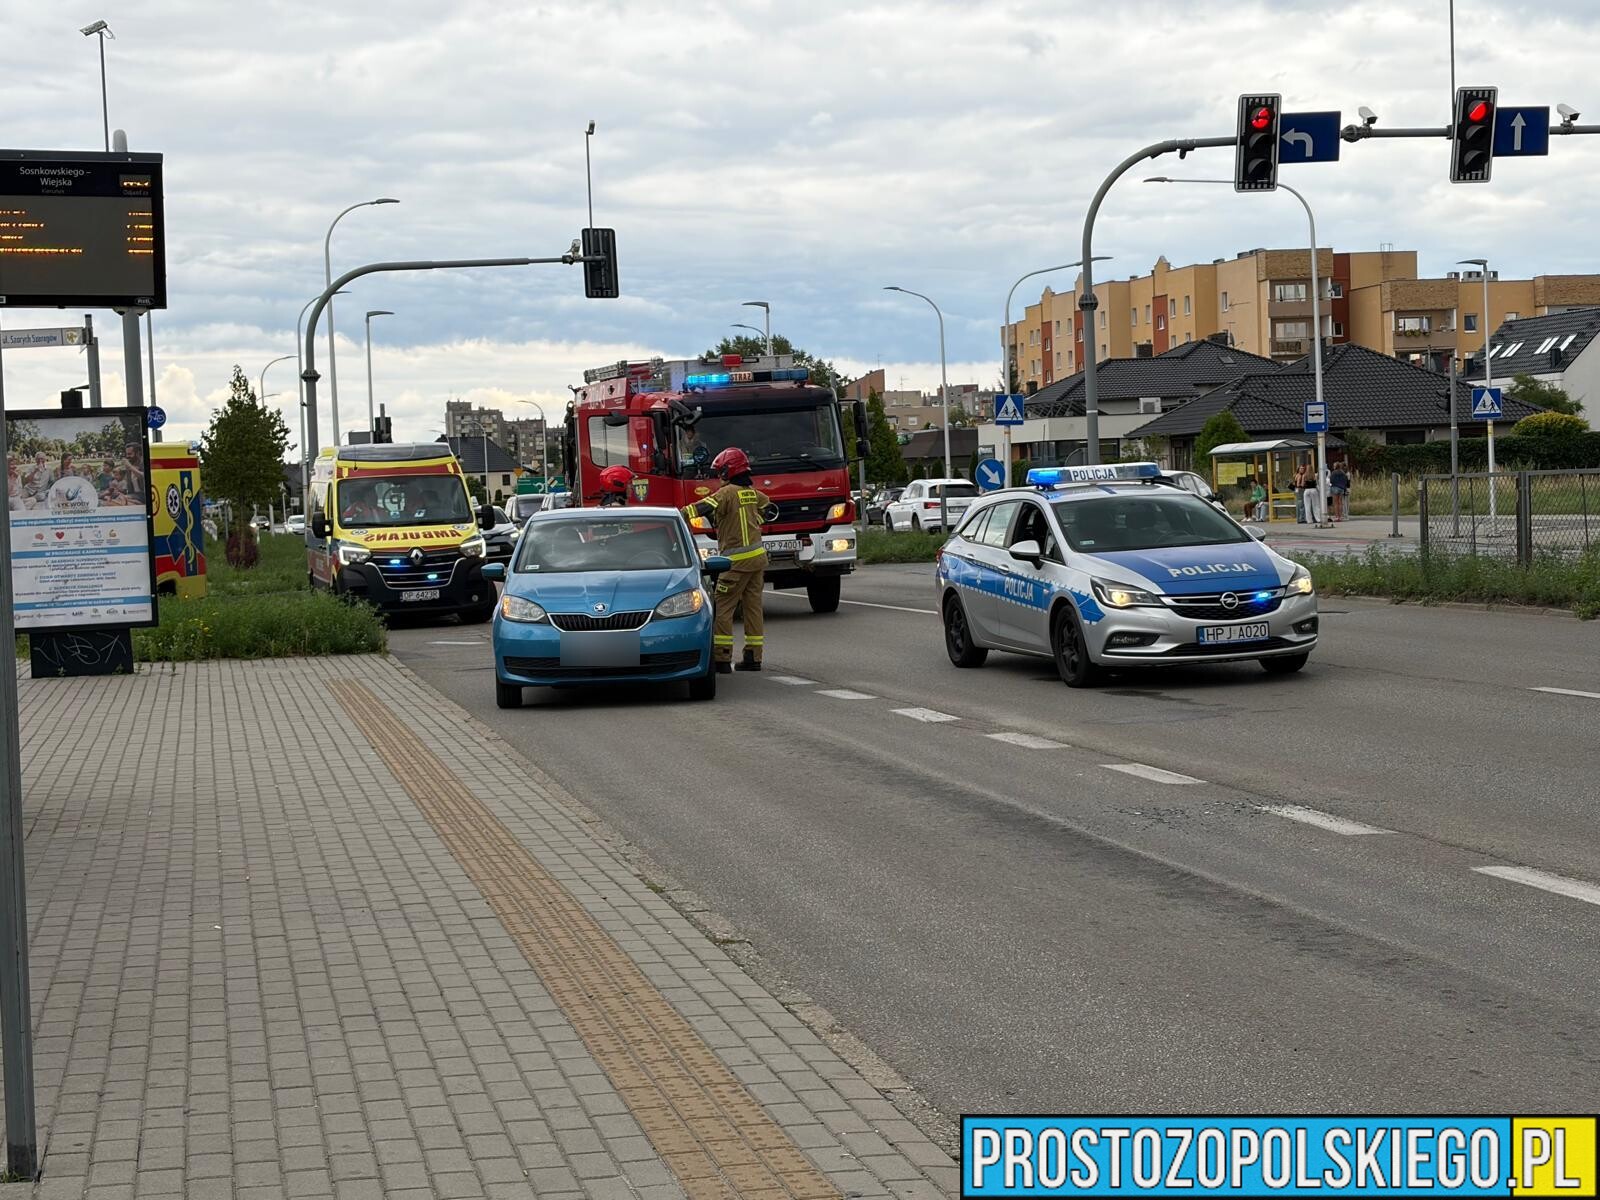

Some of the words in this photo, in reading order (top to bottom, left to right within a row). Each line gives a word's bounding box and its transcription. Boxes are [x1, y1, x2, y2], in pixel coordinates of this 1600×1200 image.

[19, 166, 85, 176] Sosnkowskiego
[40, 177, 72, 187] Wiejska
[1071, 467, 1117, 481] POLICJA
[778, 541, 802, 550] 94001
[1167, 562, 1257, 578] POLICJA
[1004, 577, 1035, 602] POLICJA
[1206, 627, 1232, 641] HPJ
[1238, 624, 1267, 639] A020
